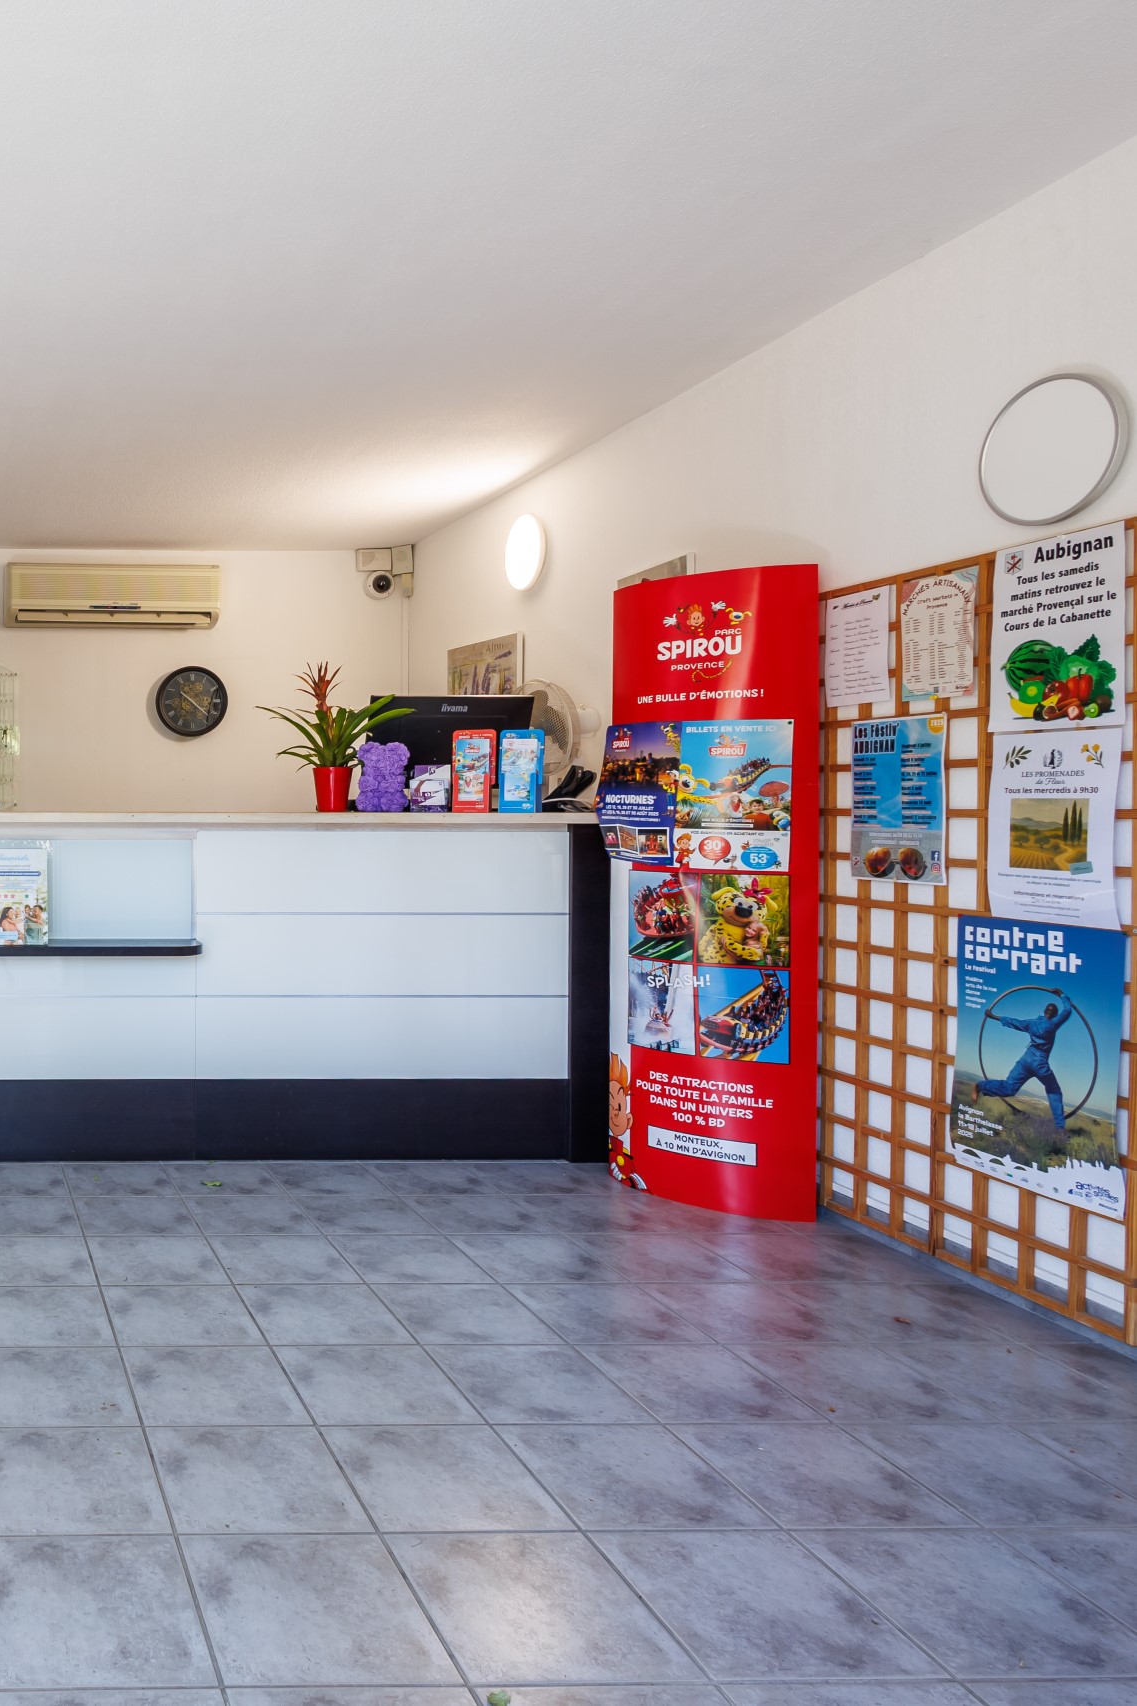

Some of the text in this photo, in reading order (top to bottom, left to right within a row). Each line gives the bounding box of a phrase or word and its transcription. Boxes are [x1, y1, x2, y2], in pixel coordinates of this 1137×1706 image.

[1034, 535, 1113, 563] Aubignan
[1017, 561, 1100, 586] Tous les samedis
[933, 579, 972, 604] ARTISANAUX
[1011, 577, 1106, 602] matins retrouvez le
[1001, 591, 1117, 618] marché Provençal sur le
[1004, 609, 1111, 632] Cours de la Cabanette
[715, 628, 742, 636] PARC
[657, 635, 742, 661] SPIROU
[671, 661, 724, 671] PROVENCE
[637, 695, 653, 705] UNE
[656, 692, 686, 703] BULLE
[689, 689, 758, 701] D'ÉMOTIONS
[441, 703, 468, 713] iiyama
[854, 726, 867, 738] Les
[612, 740, 629, 748] SPIROU
[711, 747, 744, 755] SPIROU
[854, 739, 895, 754] AUBIGNAN
[1035, 769, 1085, 777] PROMENADES
[1079, 786, 1099, 794] 9h30
[965, 925, 1064, 953] contre
[965, 944, 1082, 975] courant
[973, 965, 996, 974] festival
[647, 974, 710, 988] SPLASH!
[649, 1071, 754, 1094] DES ATTRACTIONS
[636, 1079, 774, 1109] POUR TOUTE LA FAMILLE
[649, 1094, 753, 1119] DANS UN UNIVERS
[959, 1104, 983, 1116] Avignon
[672, 1112, 725, 1128] 100 % BD
[965, 1114, 1002, 1130] Barthelasse
[958, 1129, 974, 1138] 2025
[975, 1126, 993, 1136] juillet
[655, 1138, 746, 1162] À 10 MN D'AVIGNON
[674, 1134, 724, 1150] MONTEUX,
